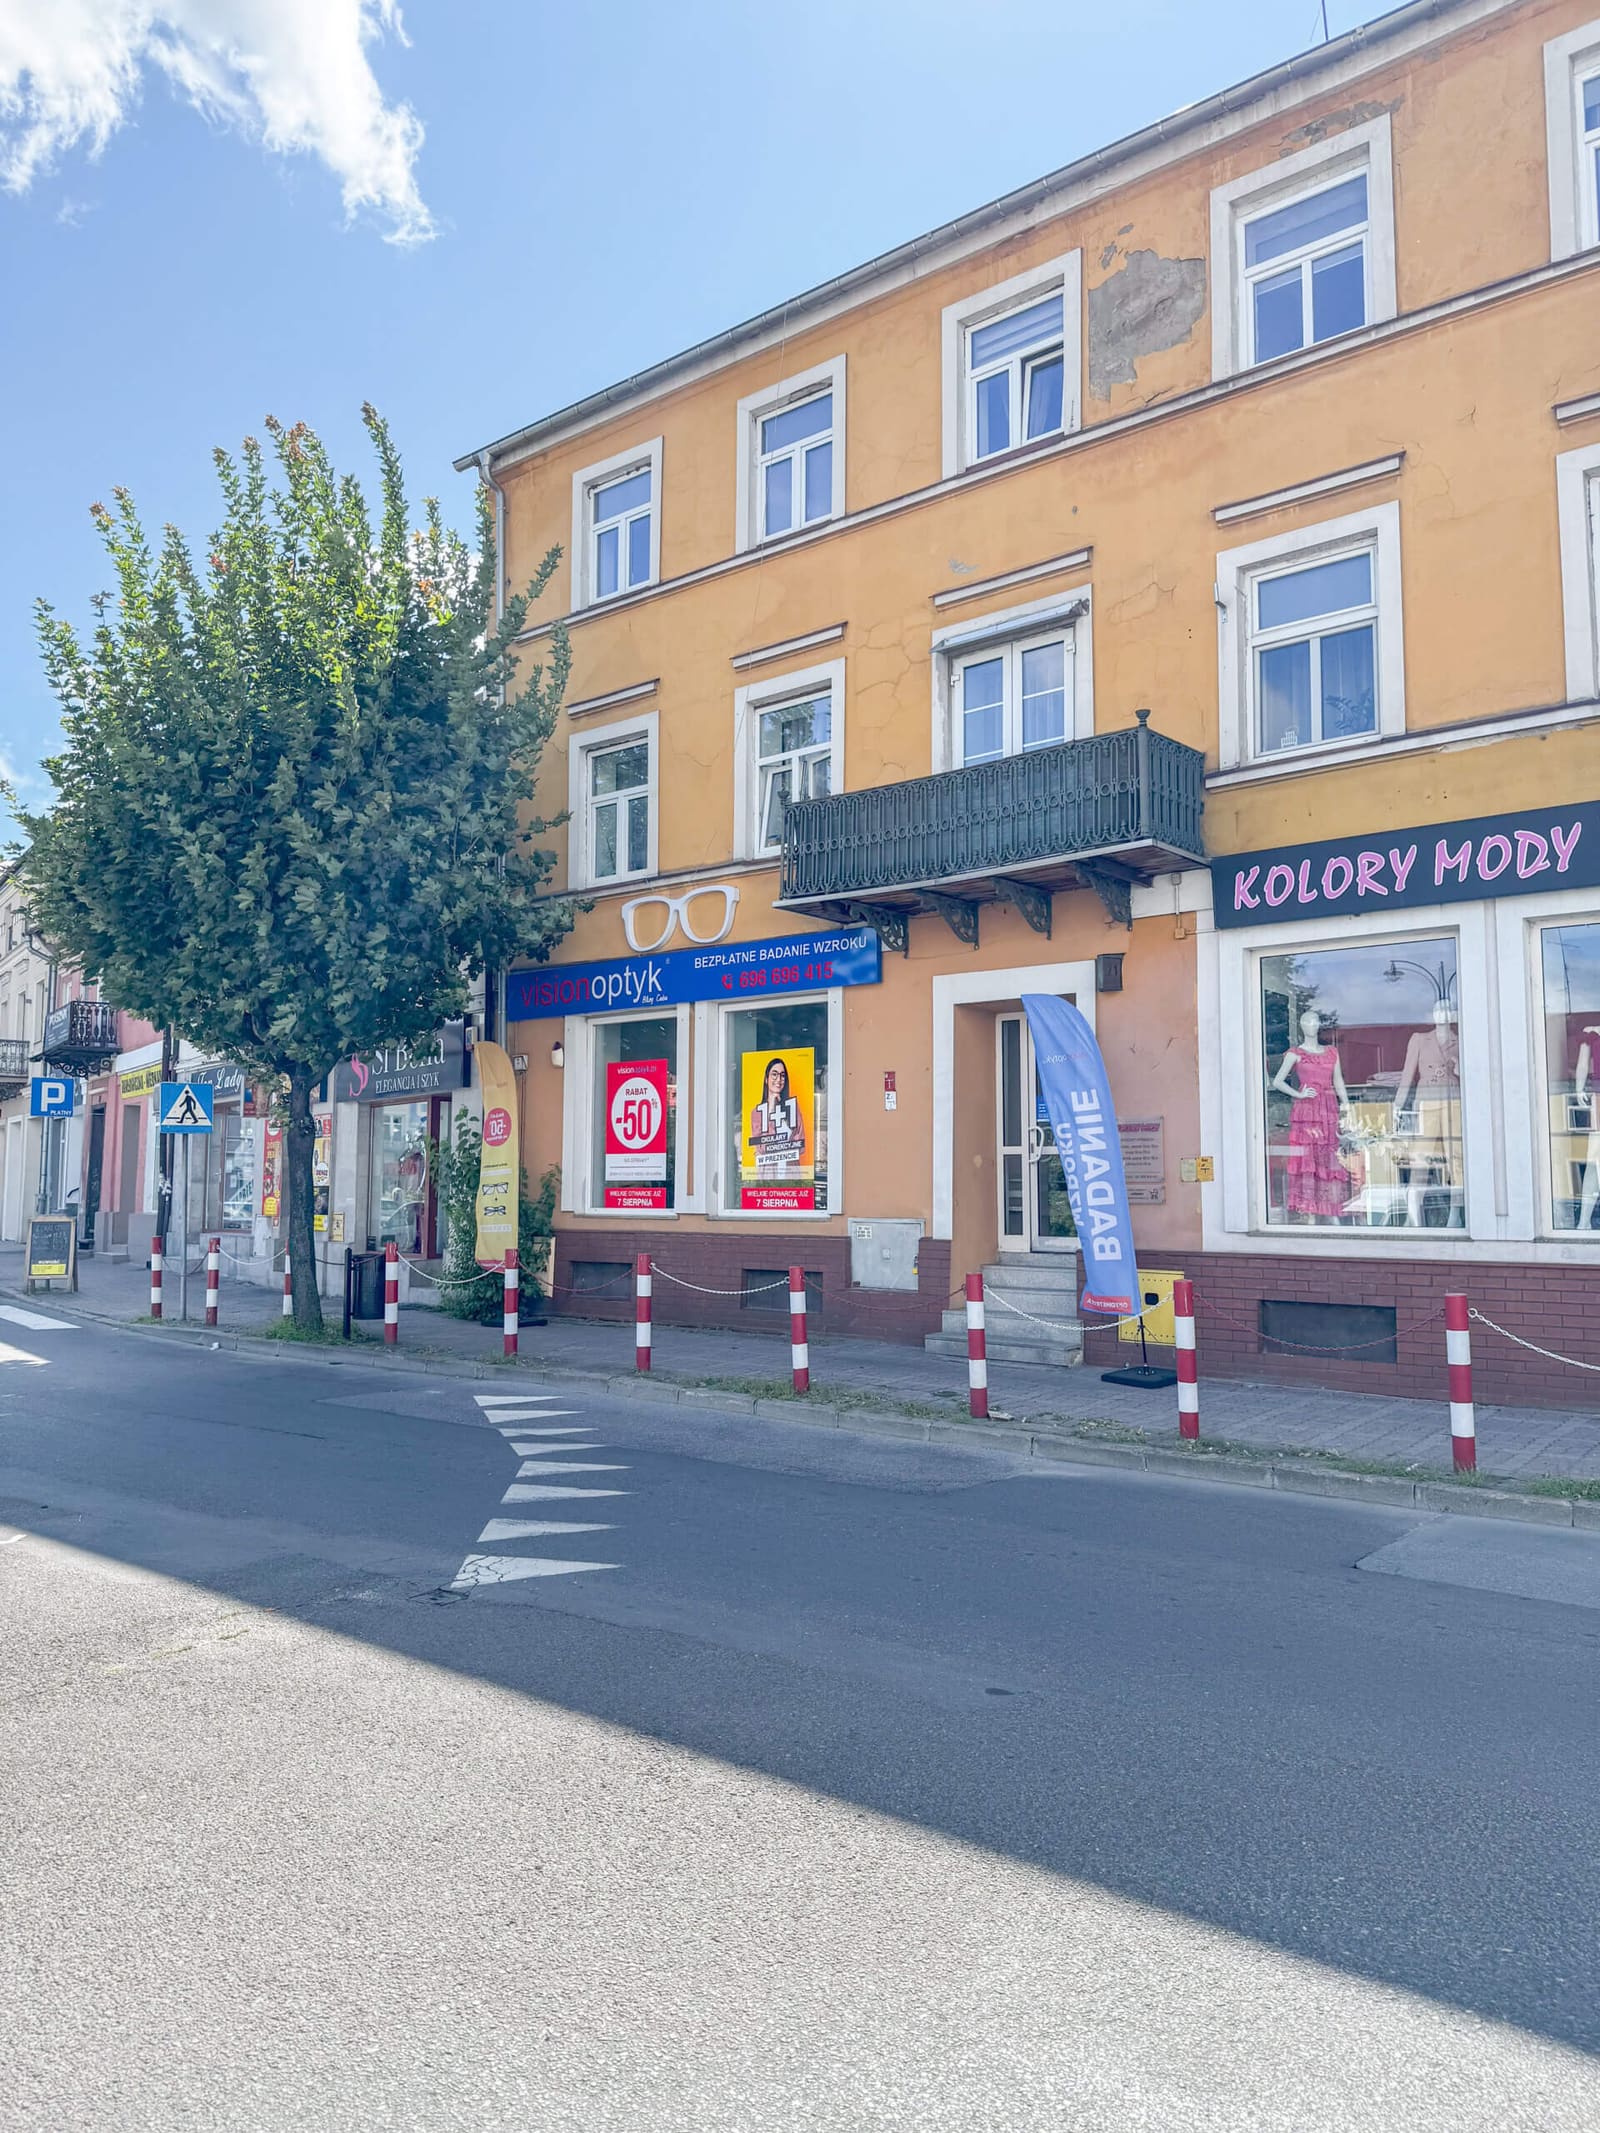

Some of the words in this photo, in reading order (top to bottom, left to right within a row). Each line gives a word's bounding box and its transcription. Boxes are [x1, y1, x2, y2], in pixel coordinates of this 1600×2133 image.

[1234, 844, 1418, 911] KOLORY
[1434, 821, 1582, 886] MODY
[694, 950, 757, 969] BEZPŁATNE
[759, 943, 811, 961] BADANIE
[813, 935, 867, 954] WZROKU
[521, 960, 662, 1007] visionoptyk
[739, 971, 767, 989] 696
[771, 965, 800, 985] 696
[804, 961, 833, 980] 415
[215, 1067, 243, 1093] Lady
[375, 1076, 416, 1094] ELEGANCJA
[420, 1072, 440, 1088] SZYK
[625, 1087, 648, 1096] RABAT
[41, 1081, 66, 1113] P
[757, 1097, 797, 1132] 1+1
[617, 1198, 622, 1206] 7
[623, 1198, 653, 1207] SIERPNIA
[762, 1199, 798, 1208] SIERPNIA
